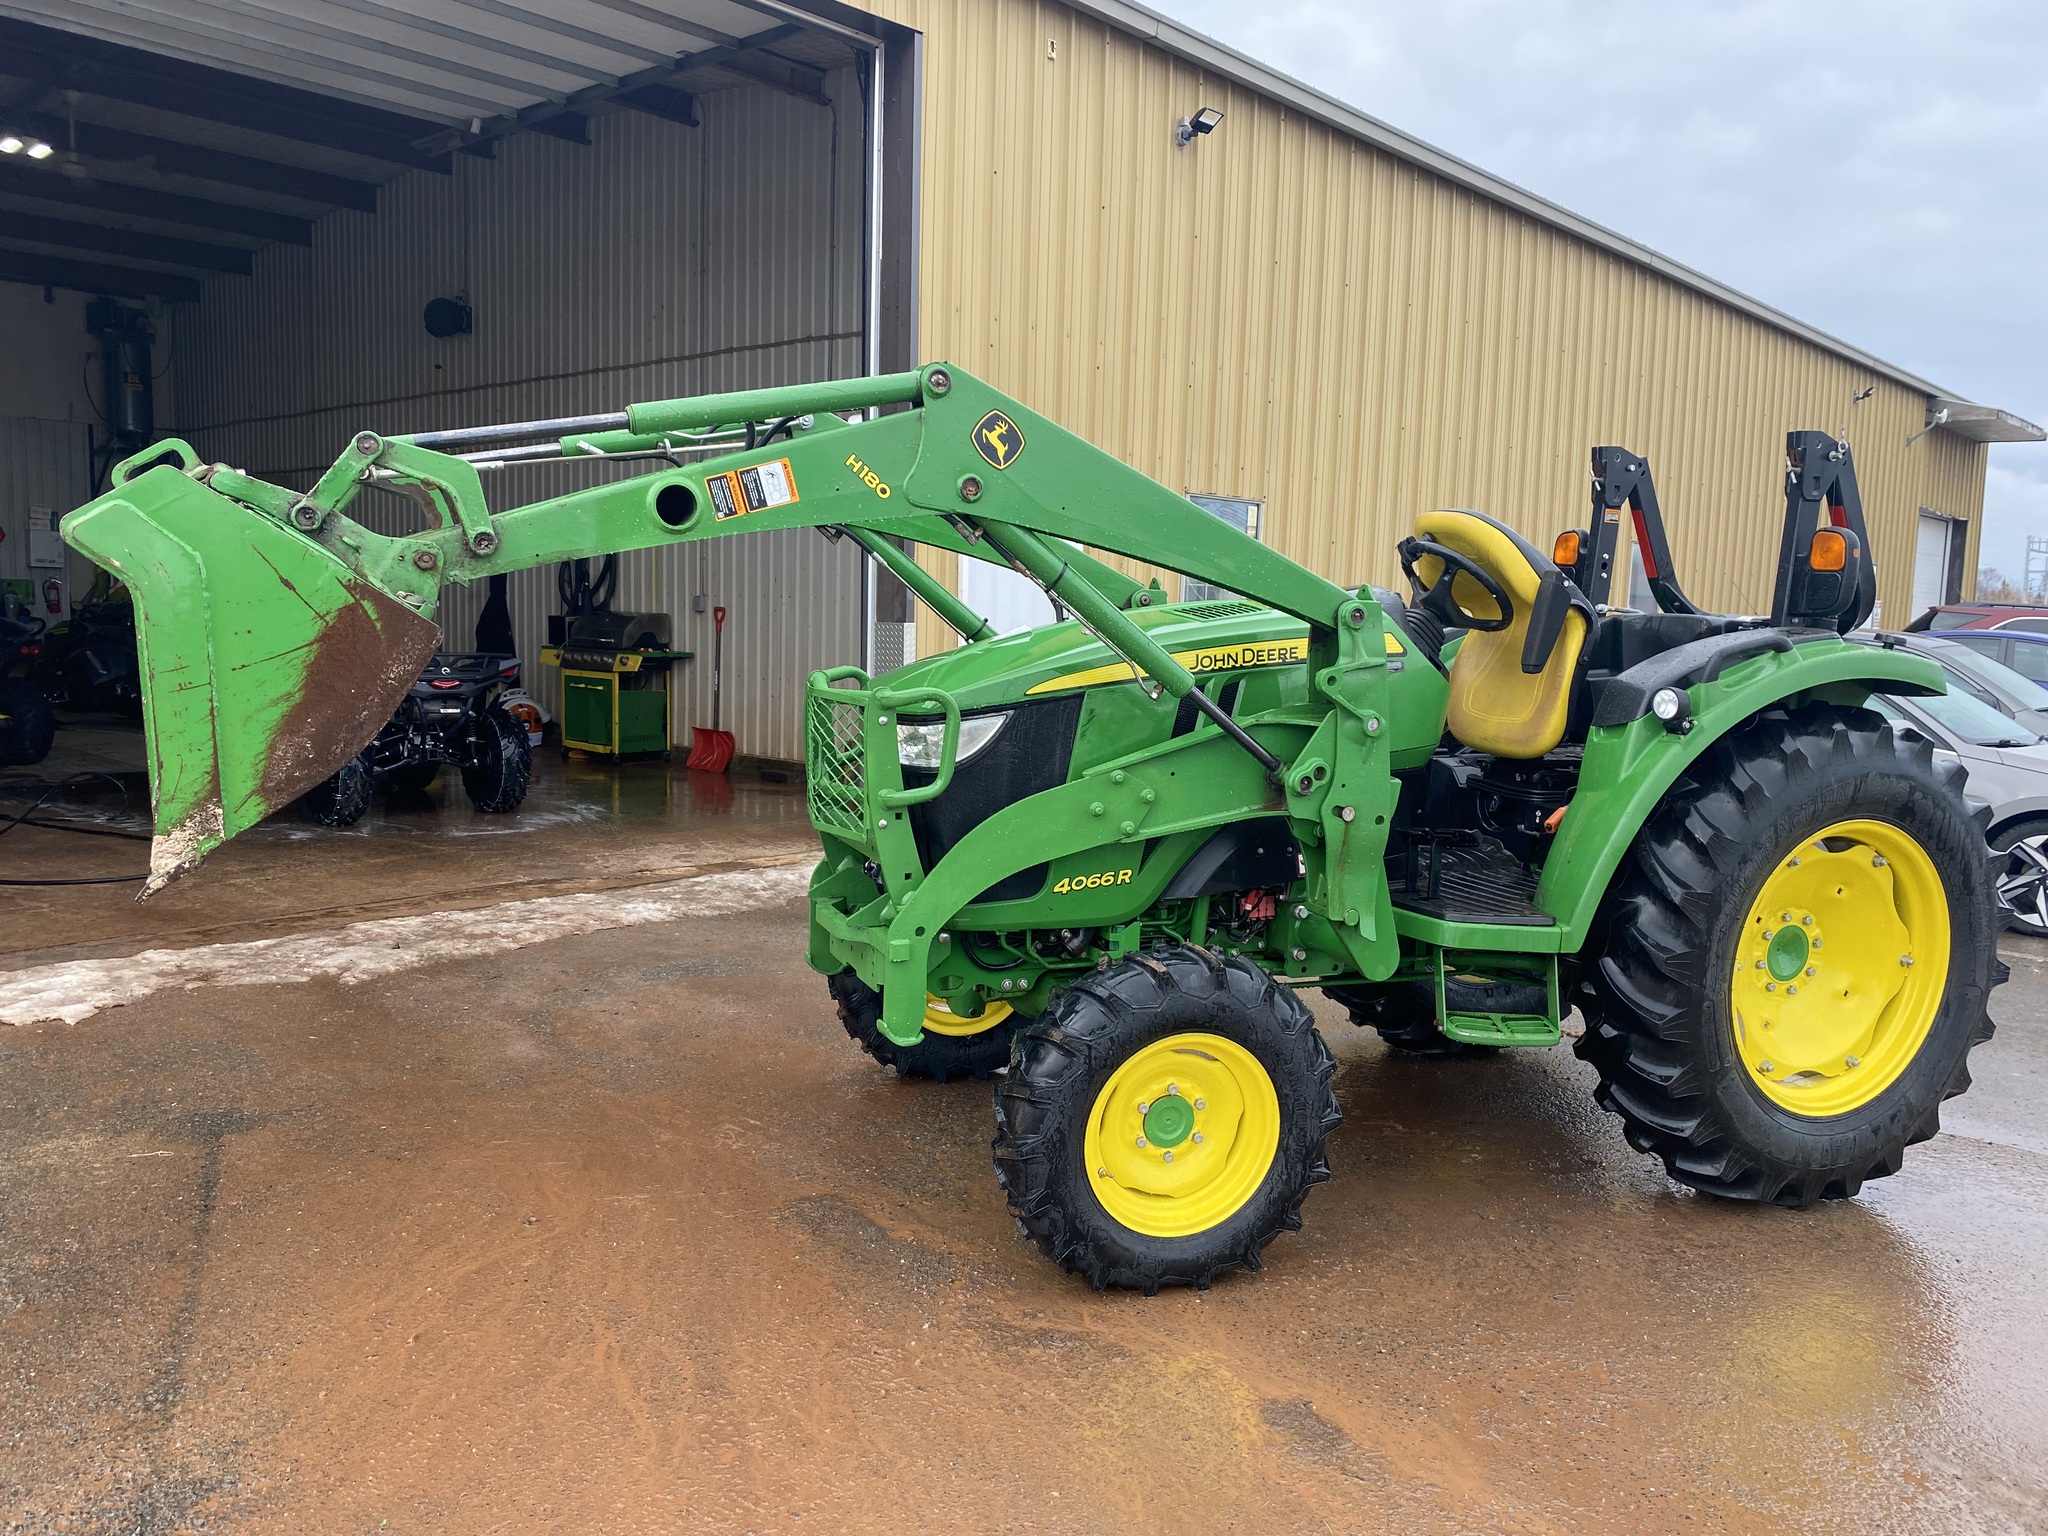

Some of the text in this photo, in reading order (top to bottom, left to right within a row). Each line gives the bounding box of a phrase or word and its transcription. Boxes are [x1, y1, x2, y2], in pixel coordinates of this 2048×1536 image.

[785, 468, 797, 497] WARNING
[844, 452, 892, 500] H180
[731, 483, 743, 511] WARNING
[1189, 647, 1299, 670] JOHN DEERE
[1053, 869, 1133, 894] 4066R
